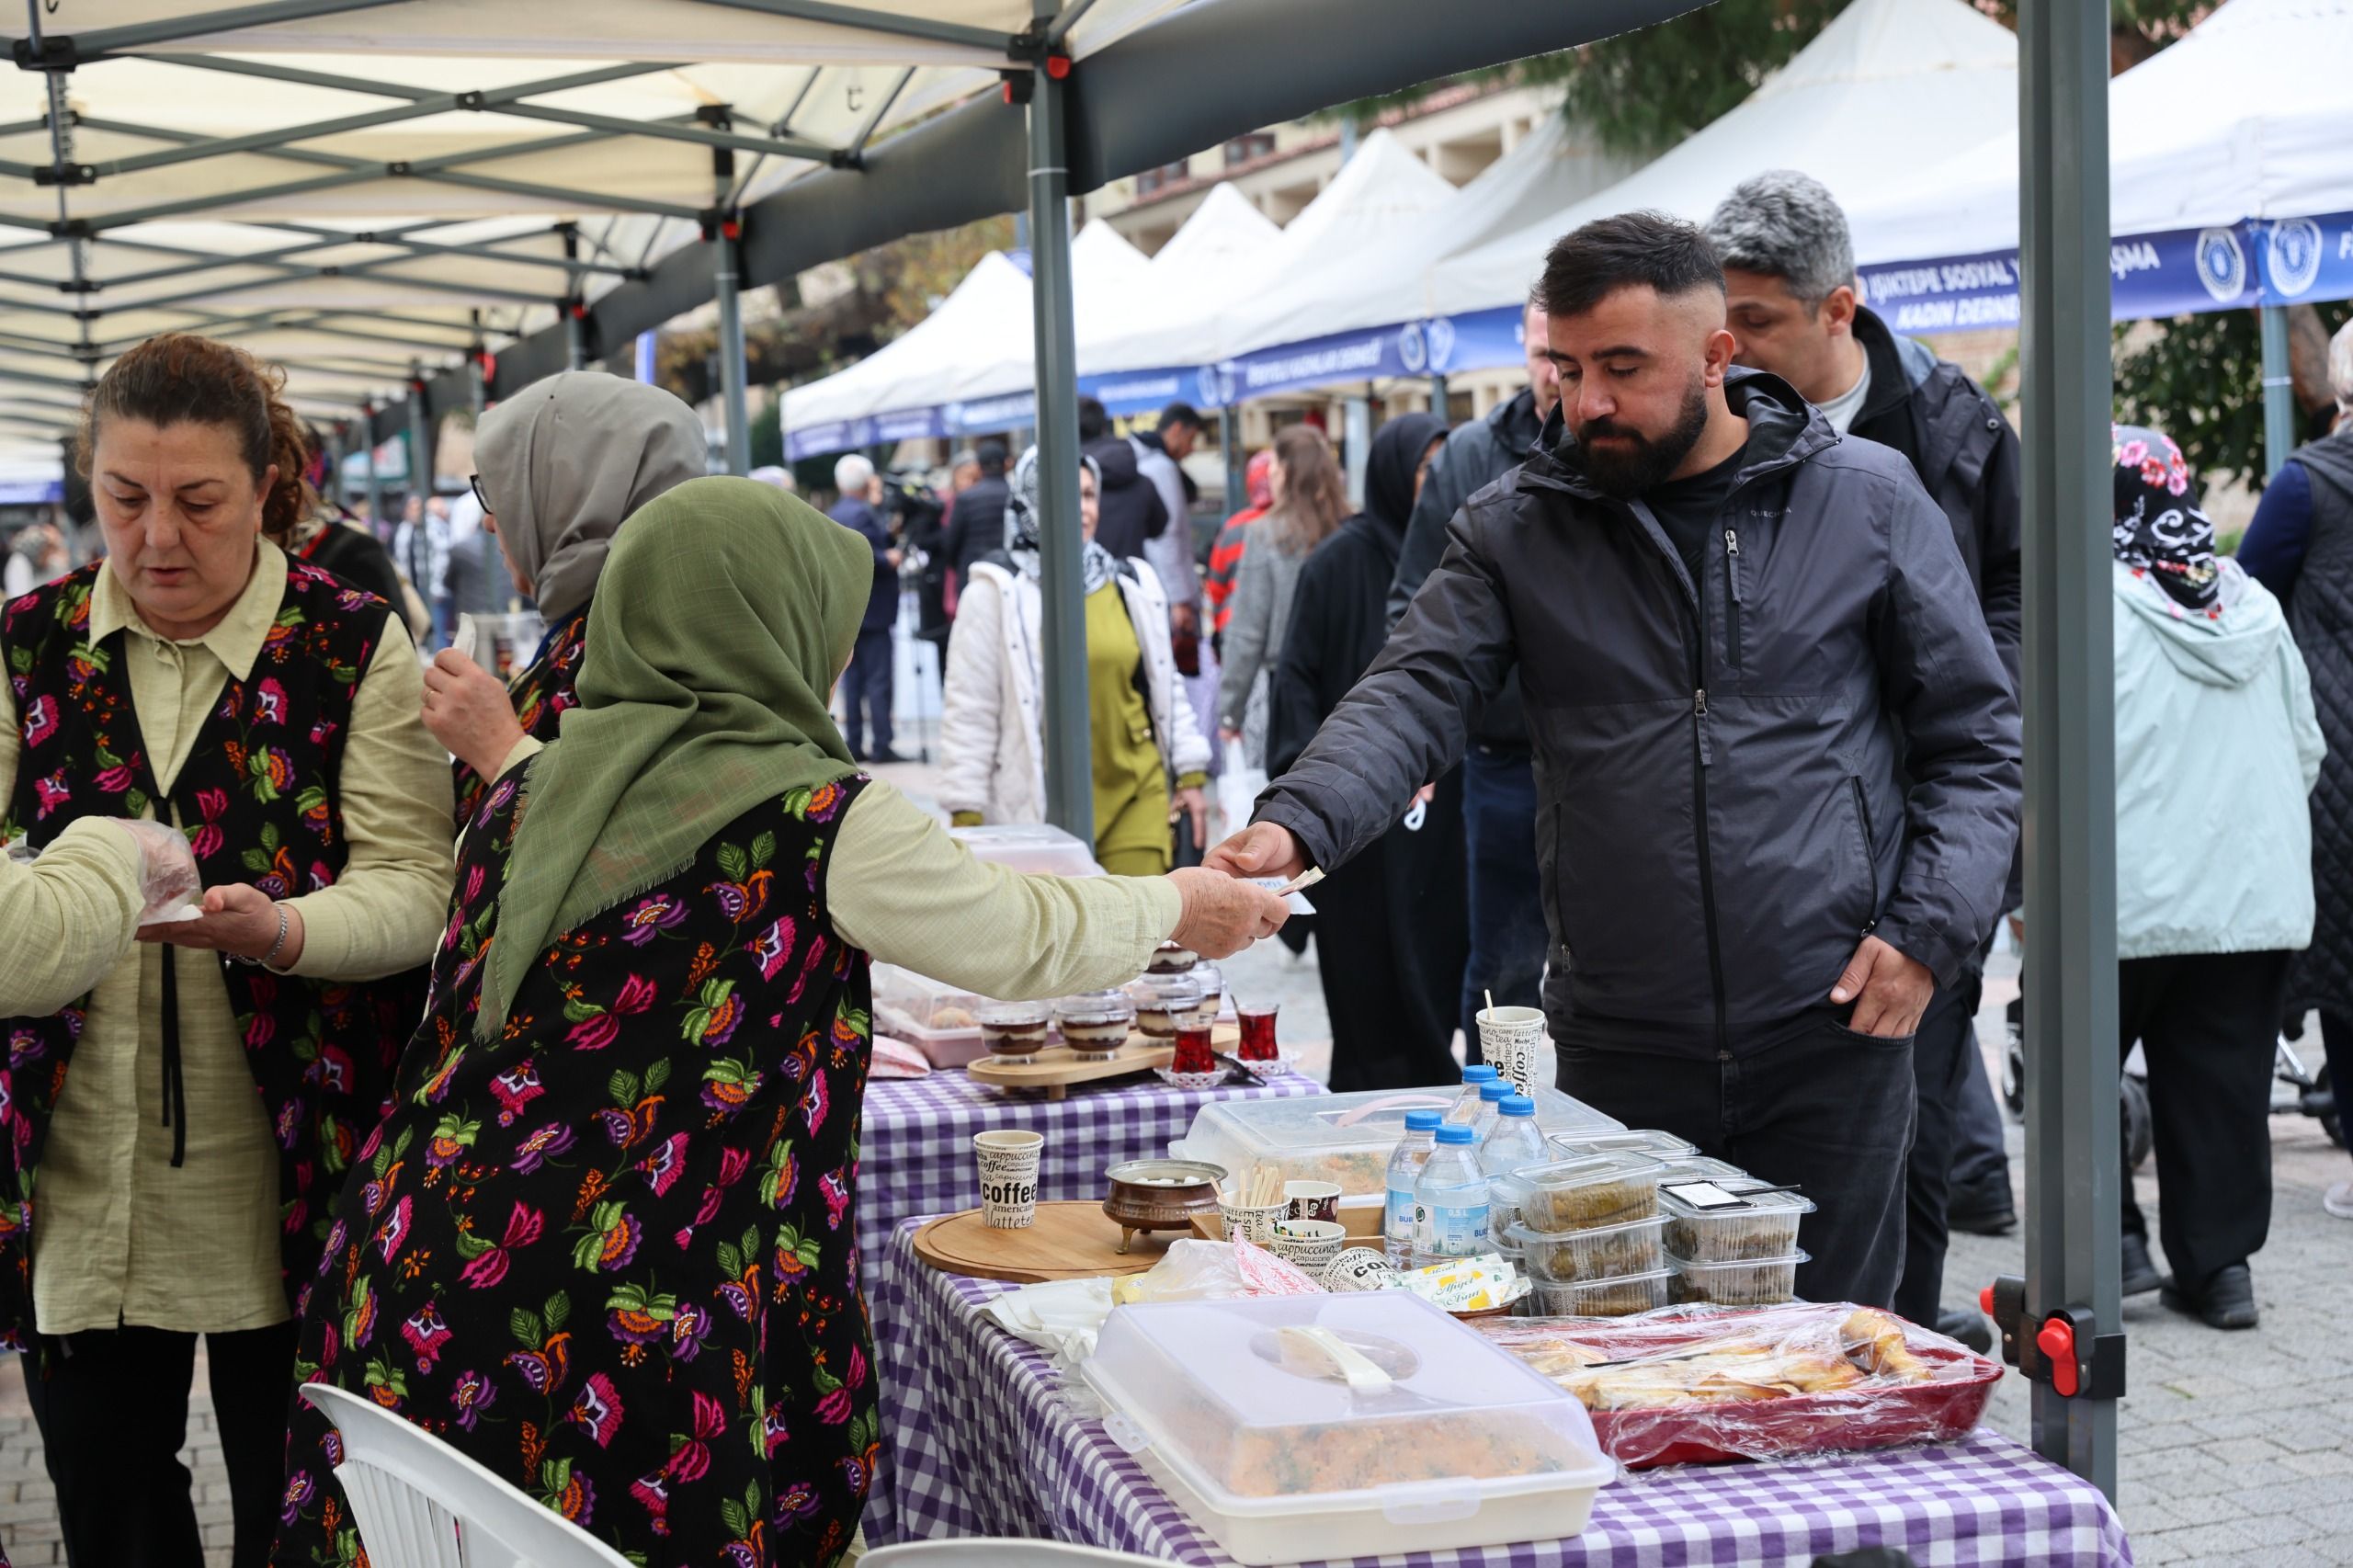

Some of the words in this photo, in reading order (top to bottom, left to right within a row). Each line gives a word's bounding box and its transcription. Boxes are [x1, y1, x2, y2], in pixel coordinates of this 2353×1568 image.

[1941, 259, 2014, 291] SOSYAL
[1895, 300, 1956, 331] KADIN
[1956, 293, 2019, 324] DERNE
[1504, 1042, 1512, 1084] cappuc
[980, 1160, 1006, 1173] coffee
[983, 1182, 1036, 1204] coffee
[1242, 1210, 1254, 1242] Espr
[1474, 1228, 1487, 1237] BUR
[1278, 1244, 1335, 1256] cappuccino
